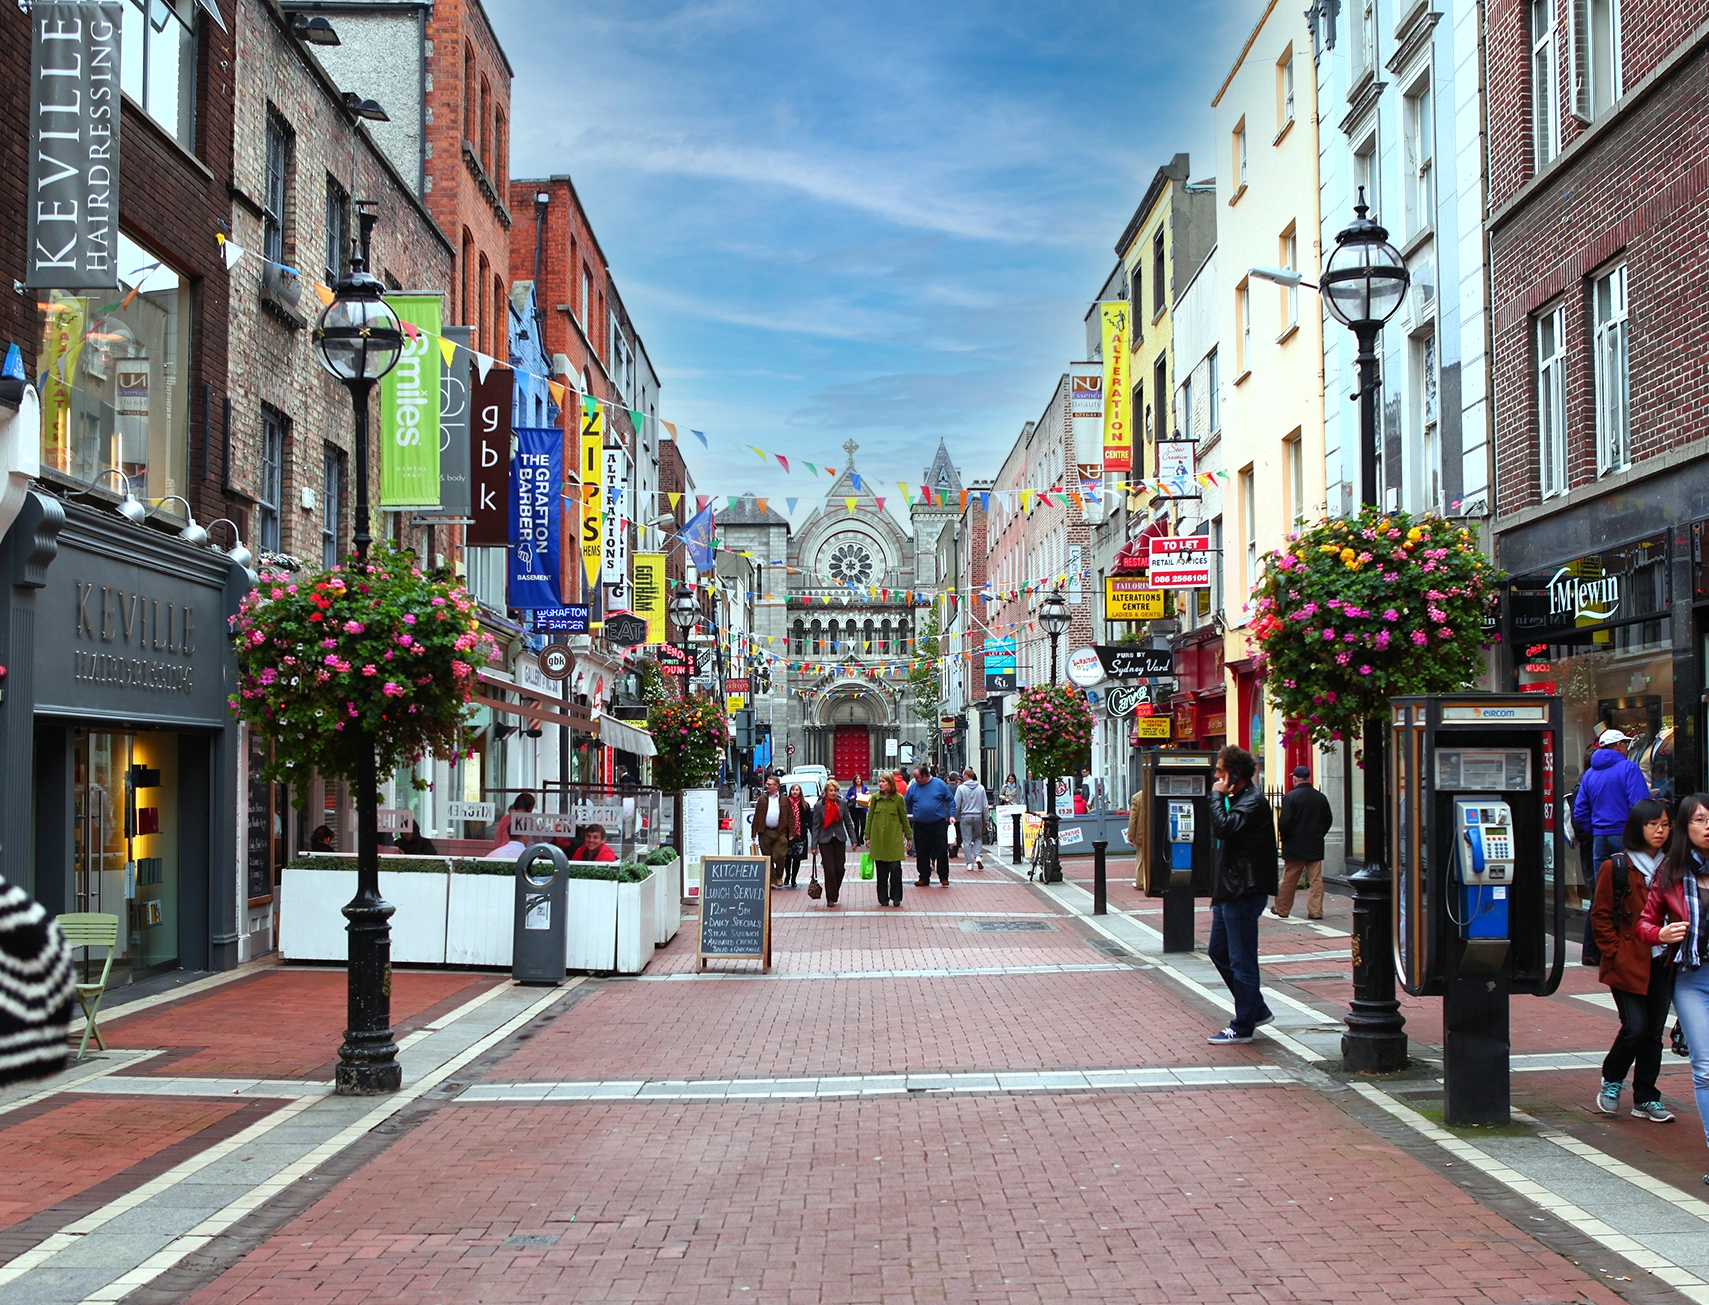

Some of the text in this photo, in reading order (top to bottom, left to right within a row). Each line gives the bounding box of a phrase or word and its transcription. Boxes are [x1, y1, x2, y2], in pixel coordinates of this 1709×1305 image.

[36, 18, 81, 271] KEVILLE
[86, 20, 113, 271] HAIRDRESSING
[1111, 334, 1123, 442] ALTERATION
[521, 454, 549, 465] THE
[1104, 451, 1129, 459] CENTRE
[447, 474, 466, 482] body
[517, 468, 533, 541] BARBER
[535, 471, 550, 554] GRAFTON
[583, 546, 600, 556] HEMS
[1163, 540, 1199, 550] TO LET
[1123, 557, 1149, 566] RESTAU
[635, 565, 654, 612] GOTHAM
[1116, 581, 1150, 589] TAILORIN
[77, 579, 196, 655] KEVILLE
[608, 621, 644, 640] EAT
[548, 656, 565, 667] gbk
[661, 646, 694, 665] KEHOS
[75, 650, 194, 694] HAIRDRESSING
[1108, 658, 1171, 677] Sydney Vard
[515, 817, 572, 833] KITCHEN
[712, 864, 758, 878] KITCHEN
[705, 884, 765, 900] LUNCH SERVED
[731, 916, 762, 928] SPECIALS
[708, 929, 728, 937] STEAK
